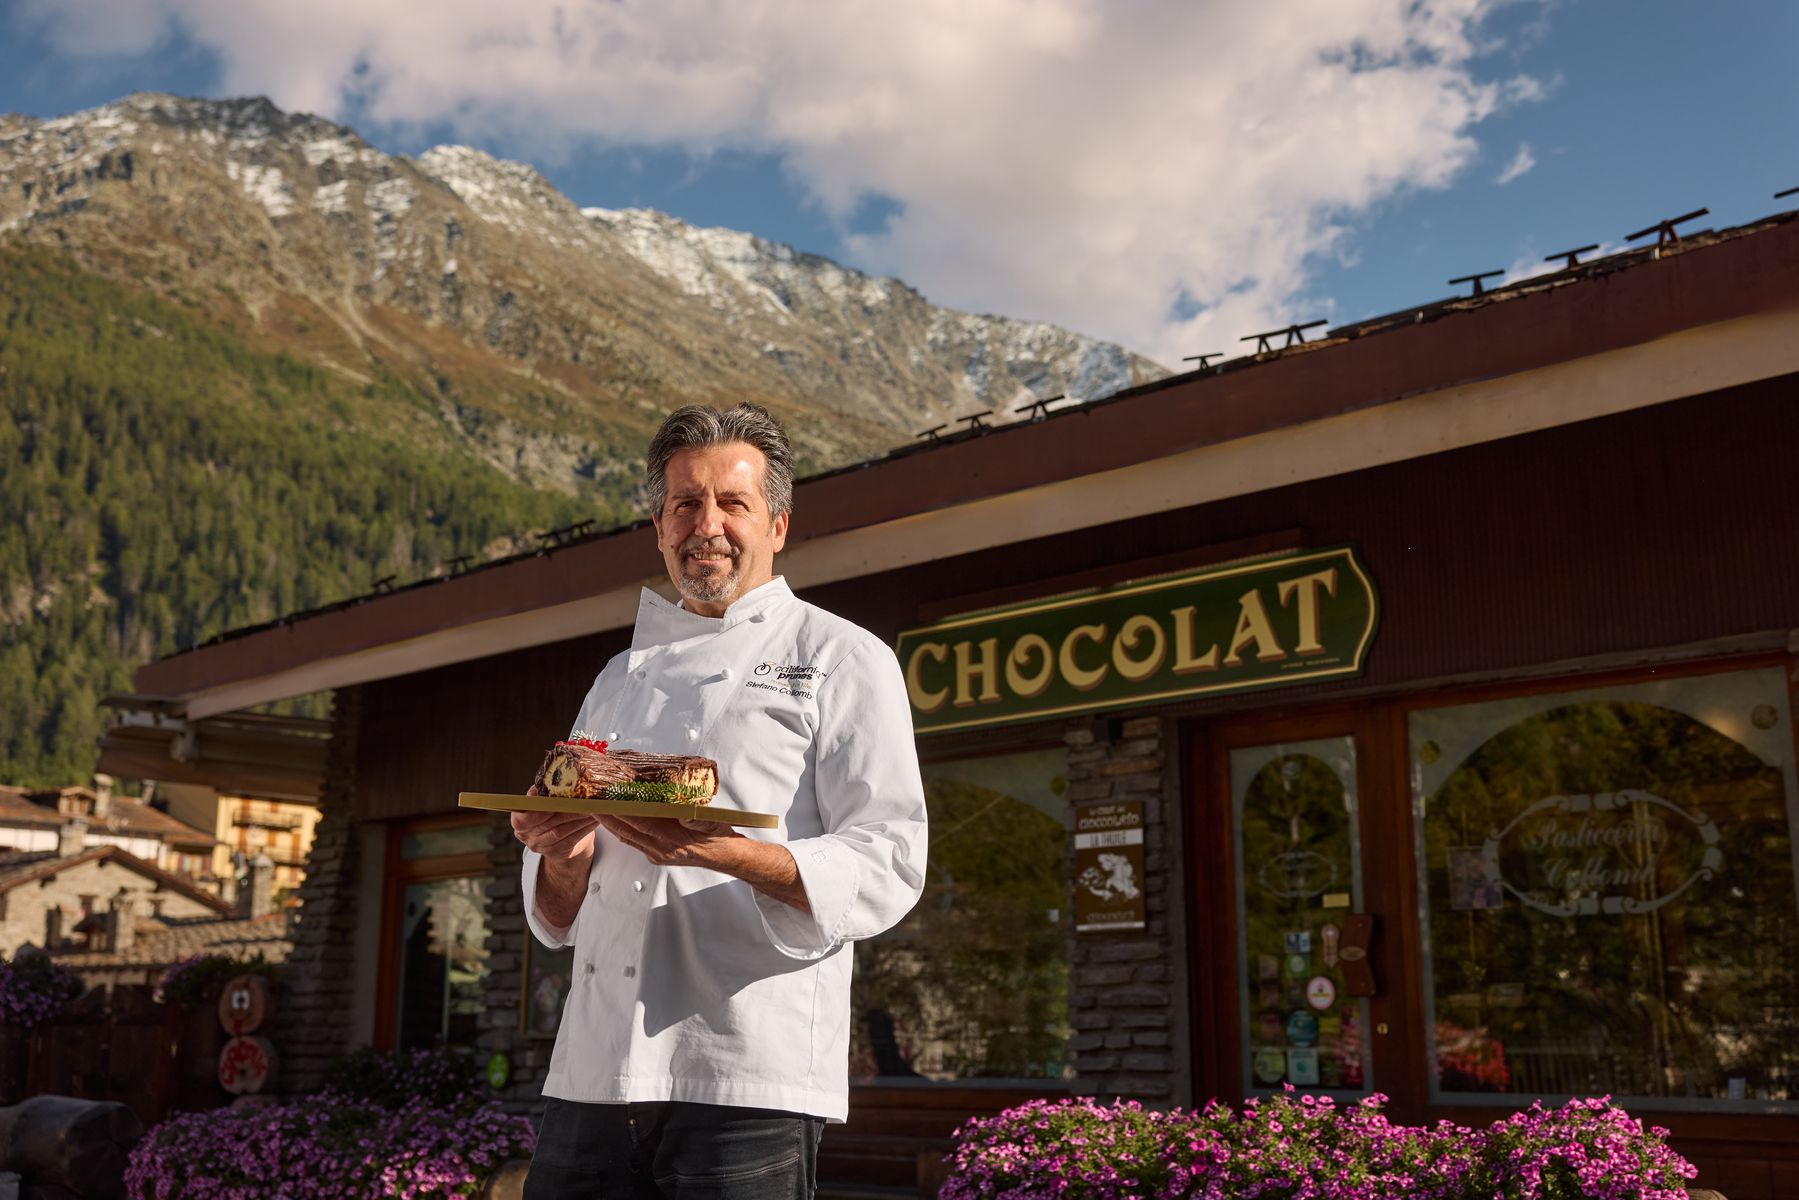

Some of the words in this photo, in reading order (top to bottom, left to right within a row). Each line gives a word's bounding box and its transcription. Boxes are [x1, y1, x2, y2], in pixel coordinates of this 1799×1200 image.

[907, 568, 1338, 714] CHOCOLAT
[774, 665, 821, 679] california
[777, 672, 813, 680] prunes
[745, 681, 778, 692] Stefano
